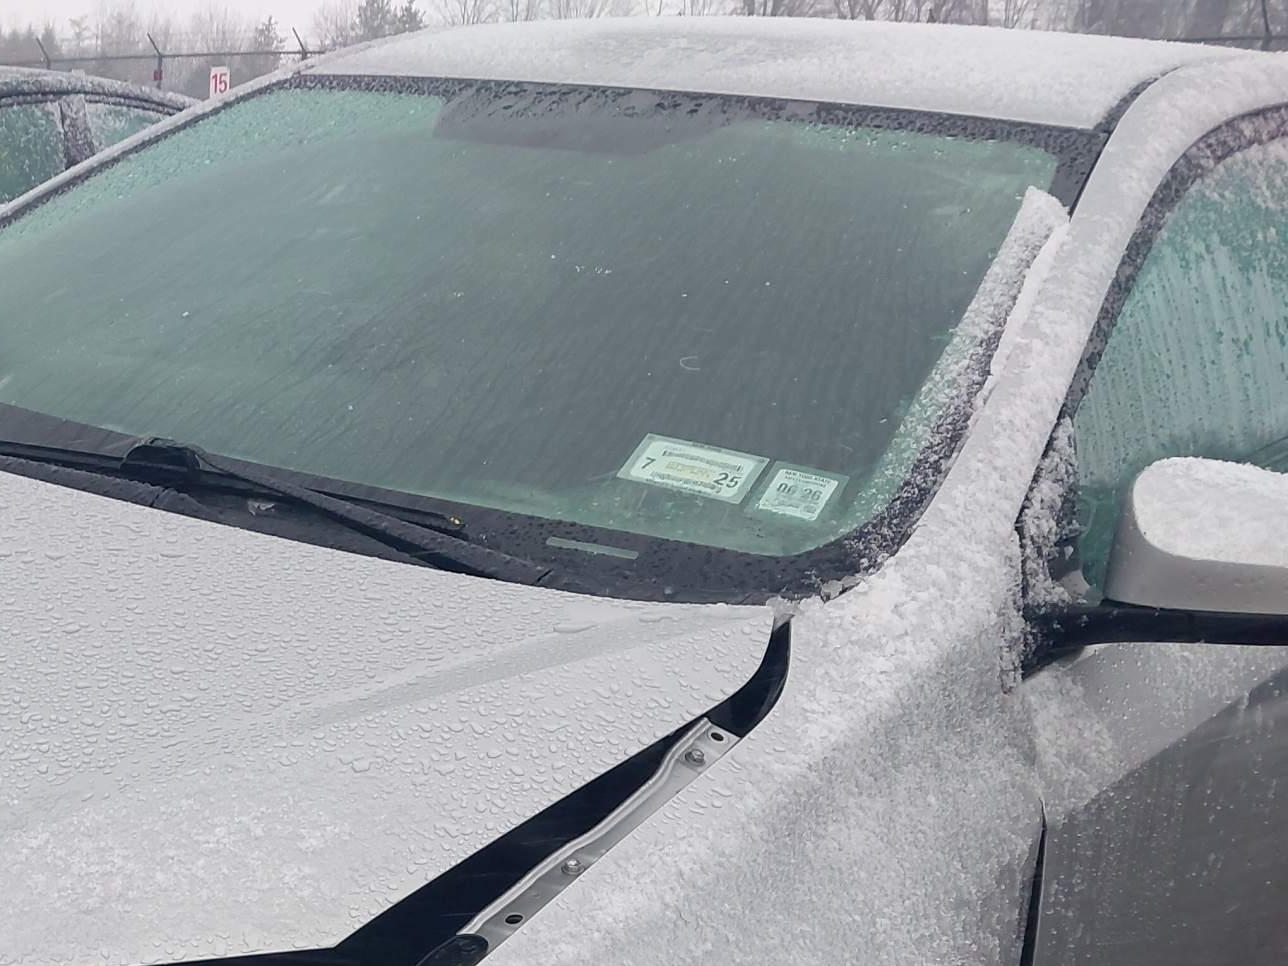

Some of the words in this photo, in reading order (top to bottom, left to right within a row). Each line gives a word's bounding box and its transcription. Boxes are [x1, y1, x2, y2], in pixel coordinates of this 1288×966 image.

[211, 73, 228, 94] 15
[641, 456, 657, 470] 7
[713, 472, 742, 489] 25
